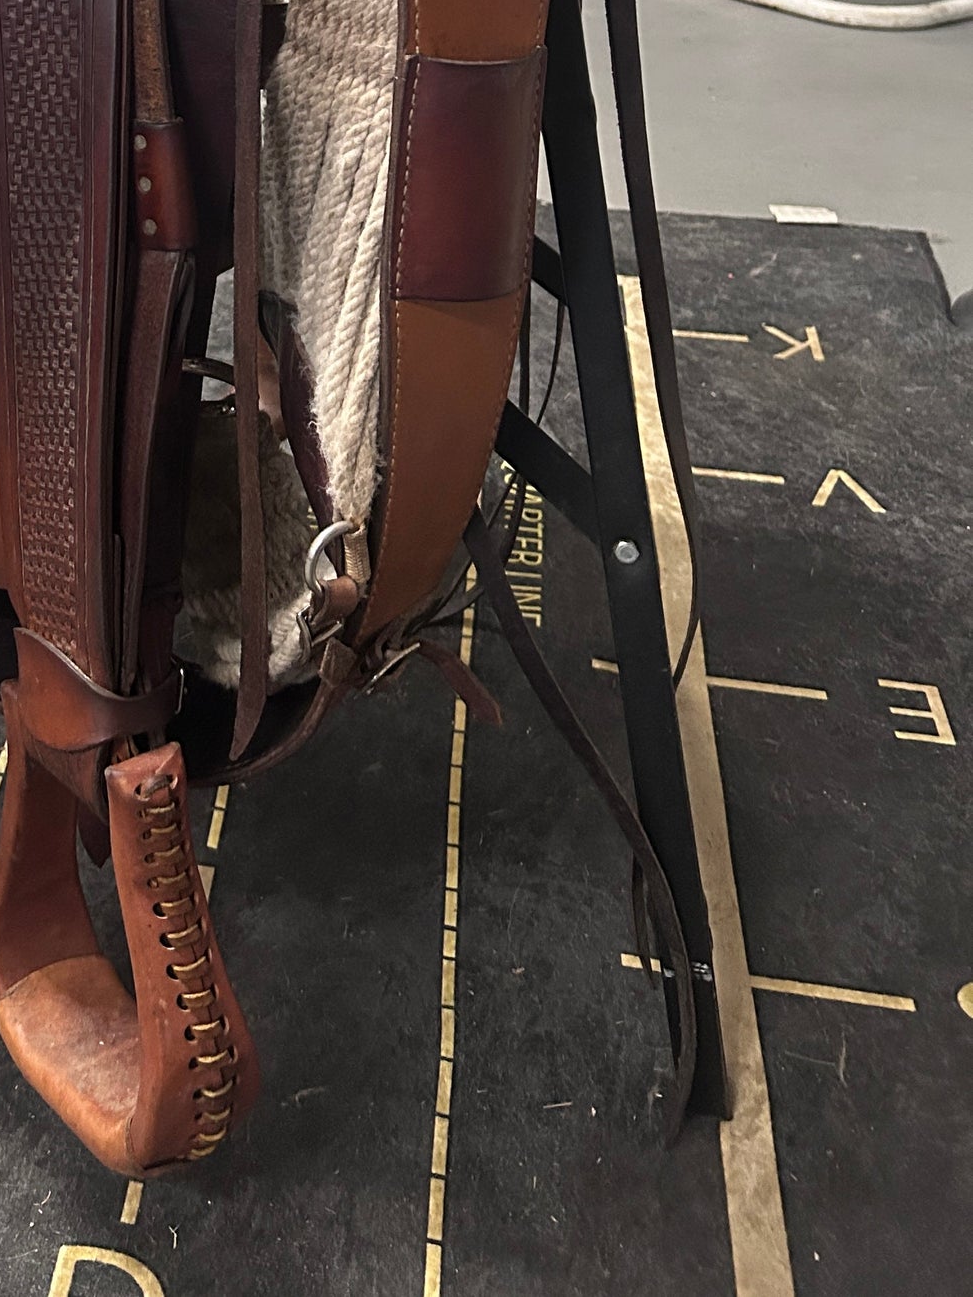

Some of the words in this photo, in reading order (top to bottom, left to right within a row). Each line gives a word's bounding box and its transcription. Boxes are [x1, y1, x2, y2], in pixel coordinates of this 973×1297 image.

[761, 322, 826, 362] K
[501, 461, 543, 567] ARTER
[811, 469, 887, 513] V
[877, 678, 957, 746] E
